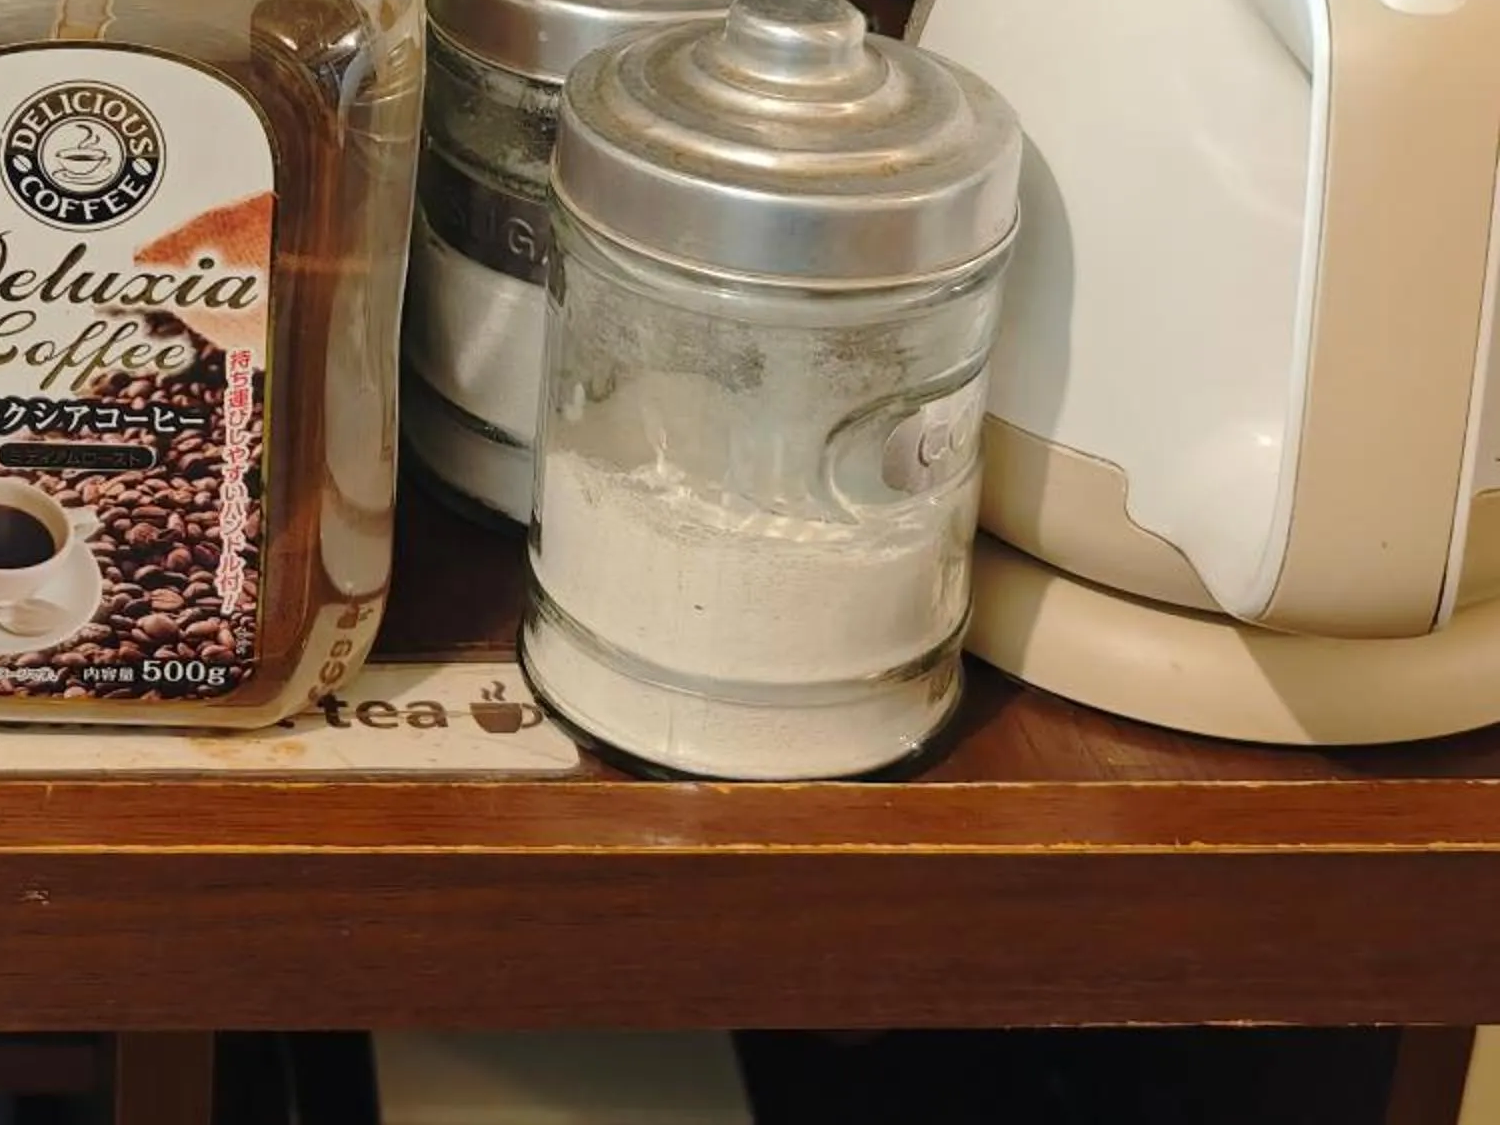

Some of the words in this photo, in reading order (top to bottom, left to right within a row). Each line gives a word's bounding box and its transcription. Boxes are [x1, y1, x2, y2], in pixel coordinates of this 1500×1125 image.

[11, 90, 154, 155] DELICIOUS
[20, 174, 146, 220] COFFEE
[83, 666, 134, 682] 内容量
[142, 660, 226, 685] 500g
[317, 692, 448, 728] tea
